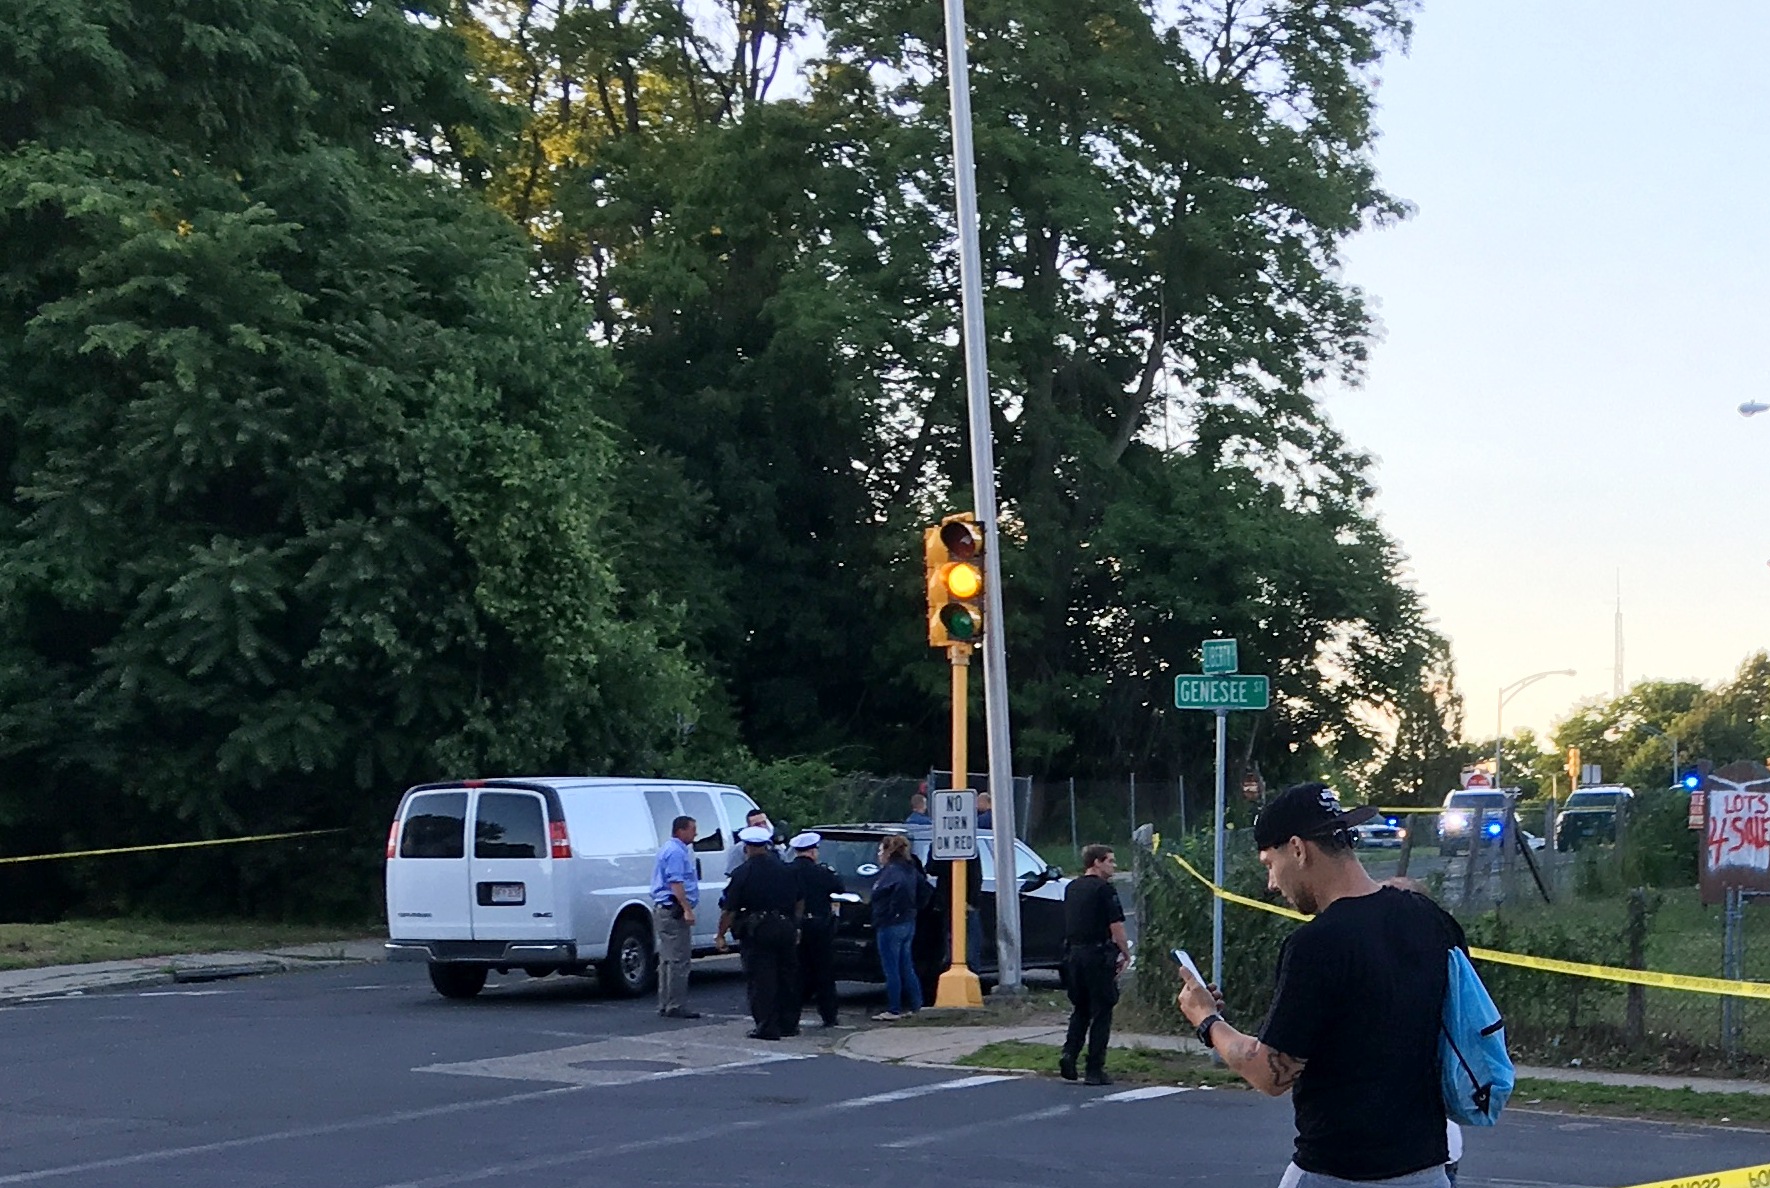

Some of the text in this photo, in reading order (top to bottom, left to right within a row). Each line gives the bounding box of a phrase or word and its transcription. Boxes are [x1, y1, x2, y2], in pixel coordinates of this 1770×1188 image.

[1180, 680, 1264, 703] GENESEE ST
[946, 795, 963, 812] NO
[1724, 795, 1769, 814] LOTS
[942, 816, 968, 830] TURN
[937, 836, 973, 850] ON RED
[1708, 816, 1770, 865] 4 SALE
